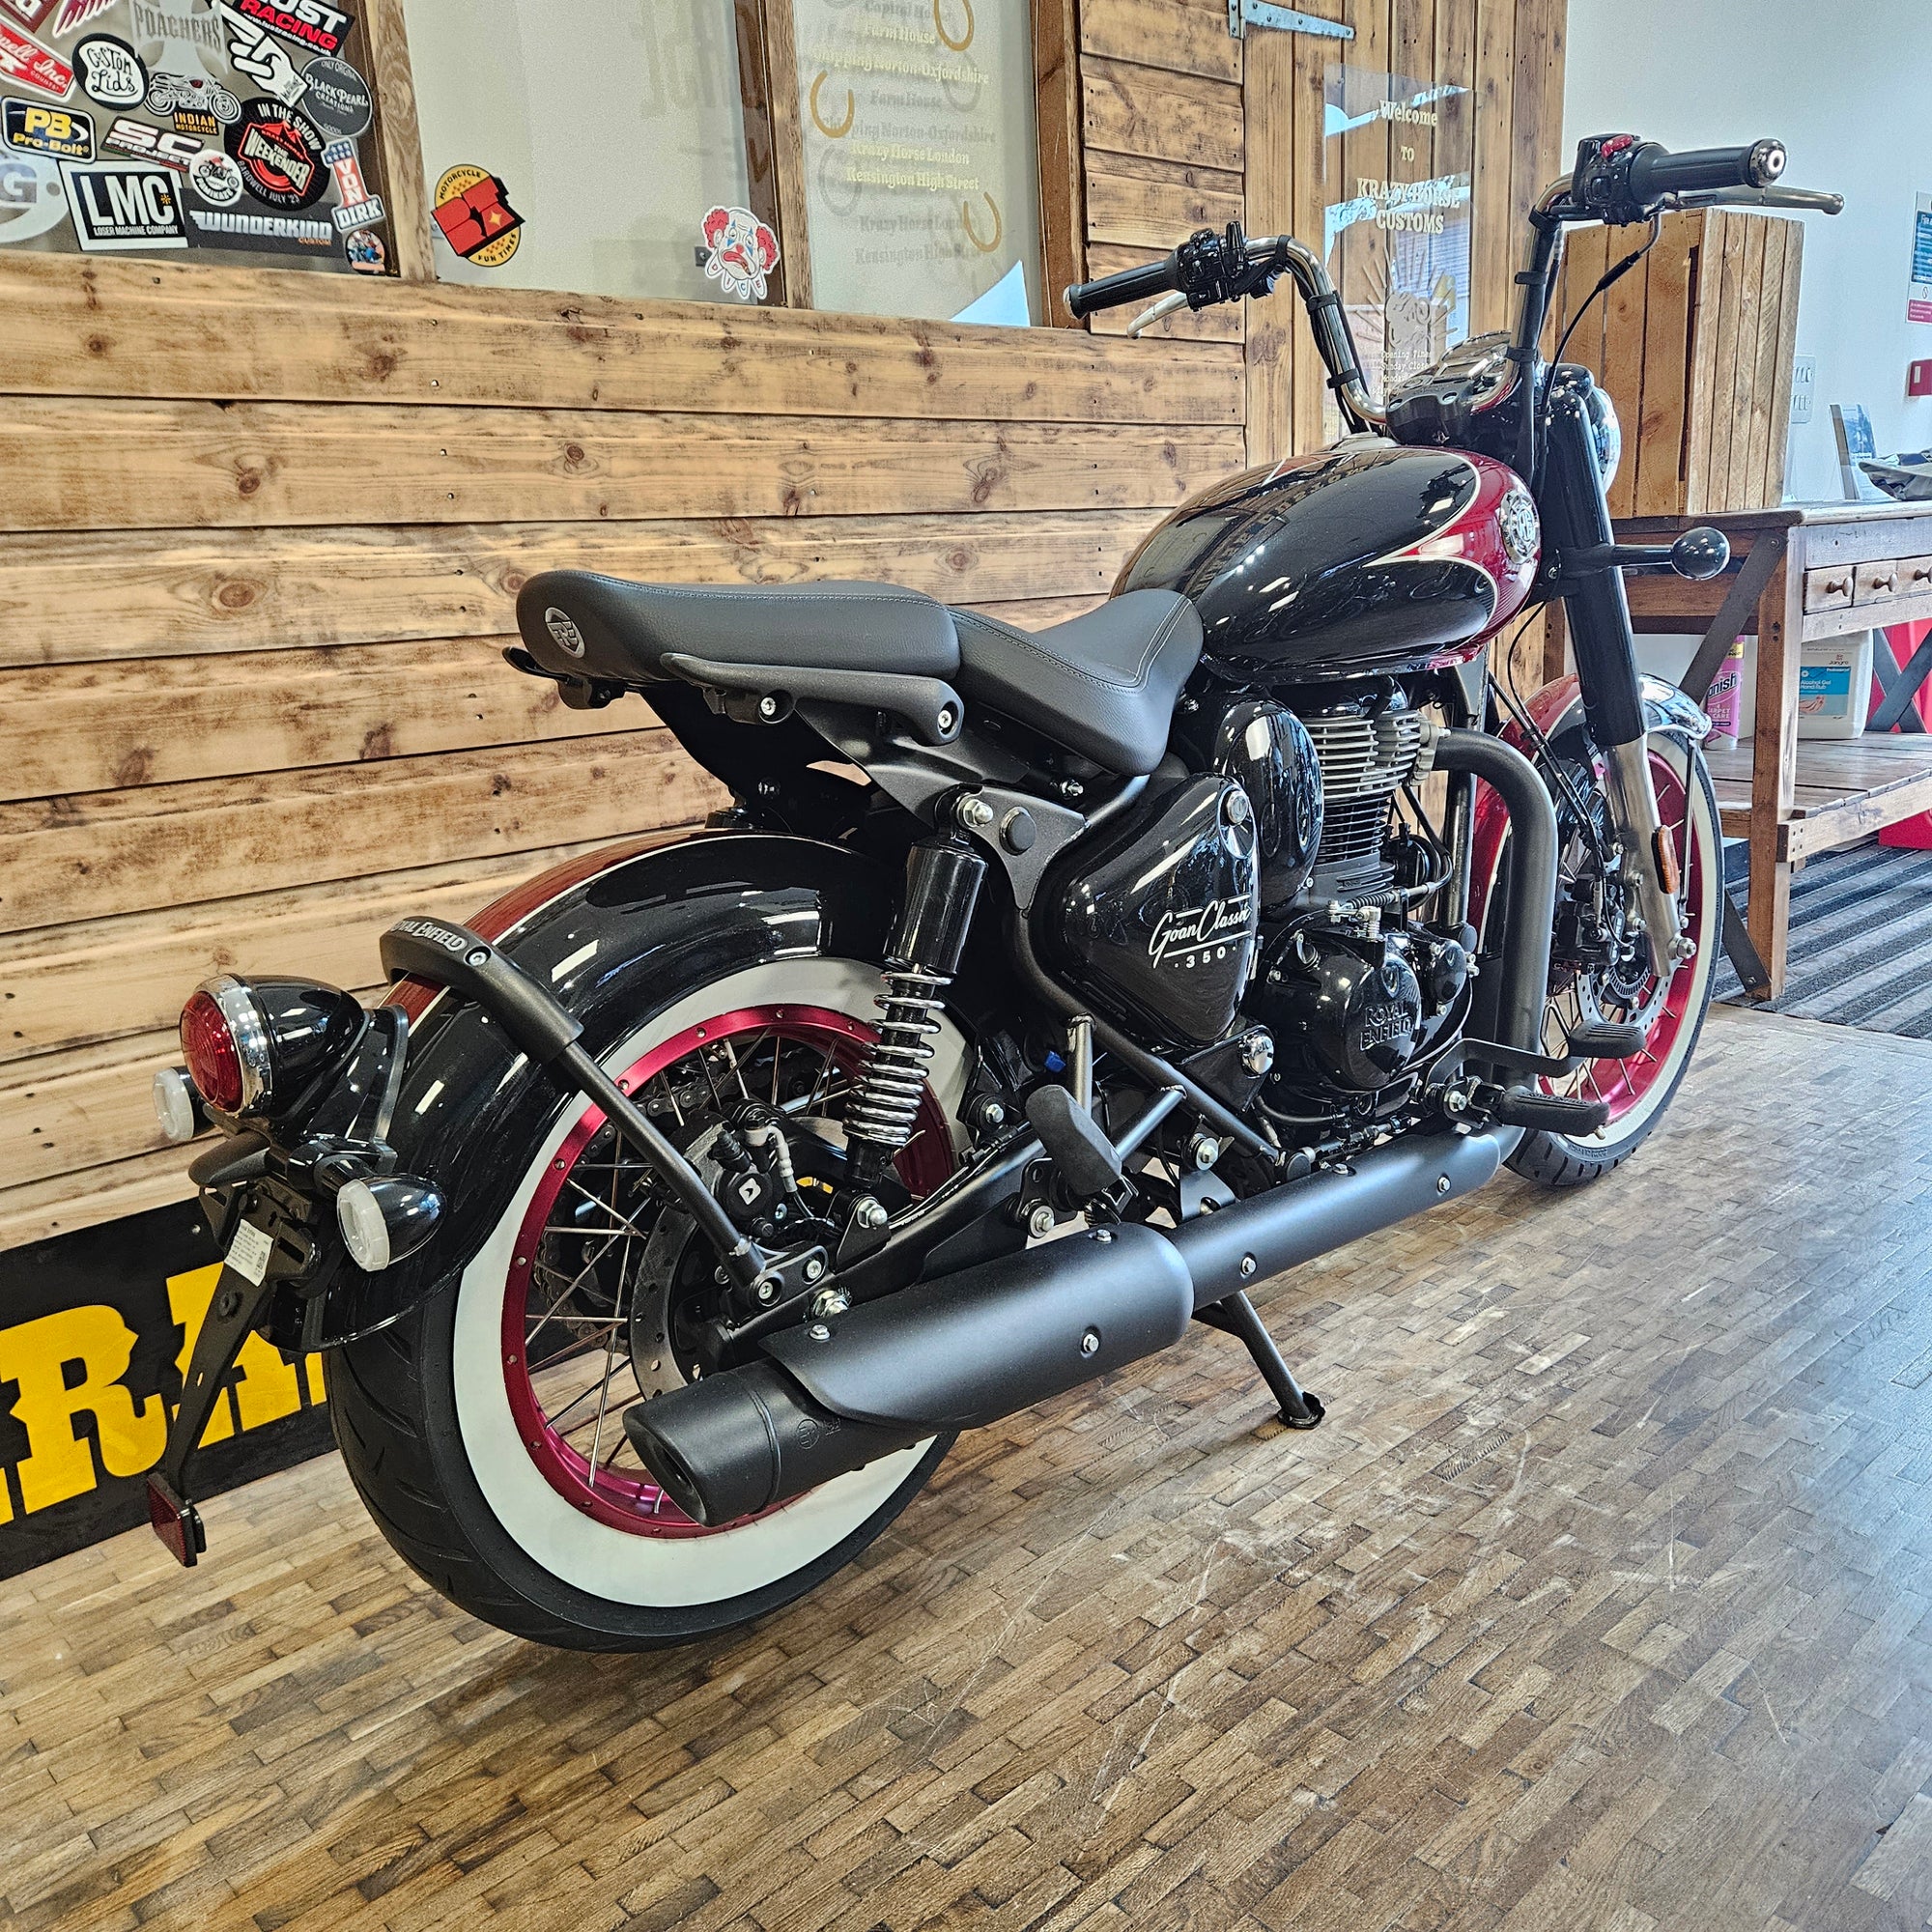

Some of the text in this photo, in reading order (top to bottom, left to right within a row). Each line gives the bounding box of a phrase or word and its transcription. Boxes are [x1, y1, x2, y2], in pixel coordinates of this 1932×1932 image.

[133, 1, 222, 54] POACHERS
[240, 0, 338, 50] RACING
[260, 0, 348, 34] UST
[865, 25, 936, 44] Farm House
[91, 70, 138, 98] Lids
[316, 91, 354, 113] CREATIONS
[1379, 100, 1438, 127] Welcome
[25, 107, 72, 140] PB
[174, 112, 216, 128] INDIAN
[175, 124, 217, 134] MOTORCYCLE
[257, 103, 322, 151] IN THE SHOW
[110, 119, 202, 158] SC
[273, 145, 289, 158] THE
[1400, 145, 1415, 162] TO
[244, 128, 310, 190] WEEKENDER
[890, 144, 925, 161] Horse
[927, 146, 970, 165] London
[237, 160, 267, 196] BARDWELL
[269, 189, 287, 204] JULY
[335, 157, 364, 207] VON
[439, 169, 481, 200] MOTORCYCLE
[846, 166, 980, 191] Kensington High Street
[1356, 177, 1461, 210] KRAZY HORSE
[79, 175, 175, 226] LMC
[339, 198, 382, 230] DIRK
[94, 224, 179, 236] LOSER MACHINE COMPANY
[189, 210, 332, 240] WUNDERKIND
[1376, 208, 1445, 235] CUSTOMS
[478, 232, 517, 263] FUN TIMES
[1708, 671, 1739, 698] anish
[413, 921, 469, 952] ENFIELD
[1148, 910, 1197, 969] Goan
[1185, 946, 1227, 969] 350
[1365, 1000, 1408, 1028] ROYAL
[1360, 1017, 1415, 1052] ENFIELD
